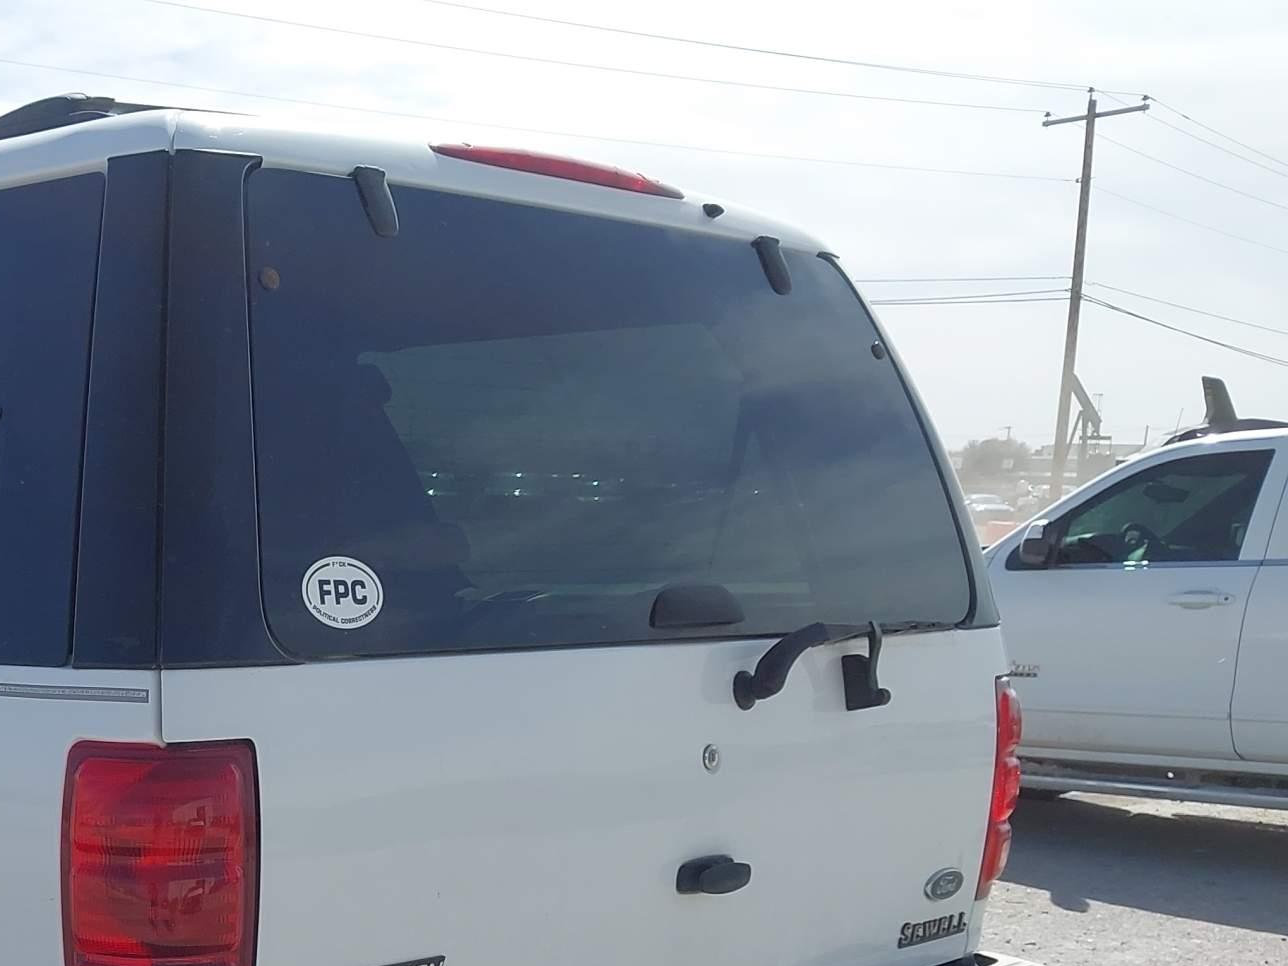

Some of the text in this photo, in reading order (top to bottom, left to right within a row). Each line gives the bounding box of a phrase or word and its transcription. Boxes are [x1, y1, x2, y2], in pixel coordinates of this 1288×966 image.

[317, 578, 368, 606] FPC
[311, 604, 340, 624] POLITICAL
[899, 911, 967, 948] SEWELL
